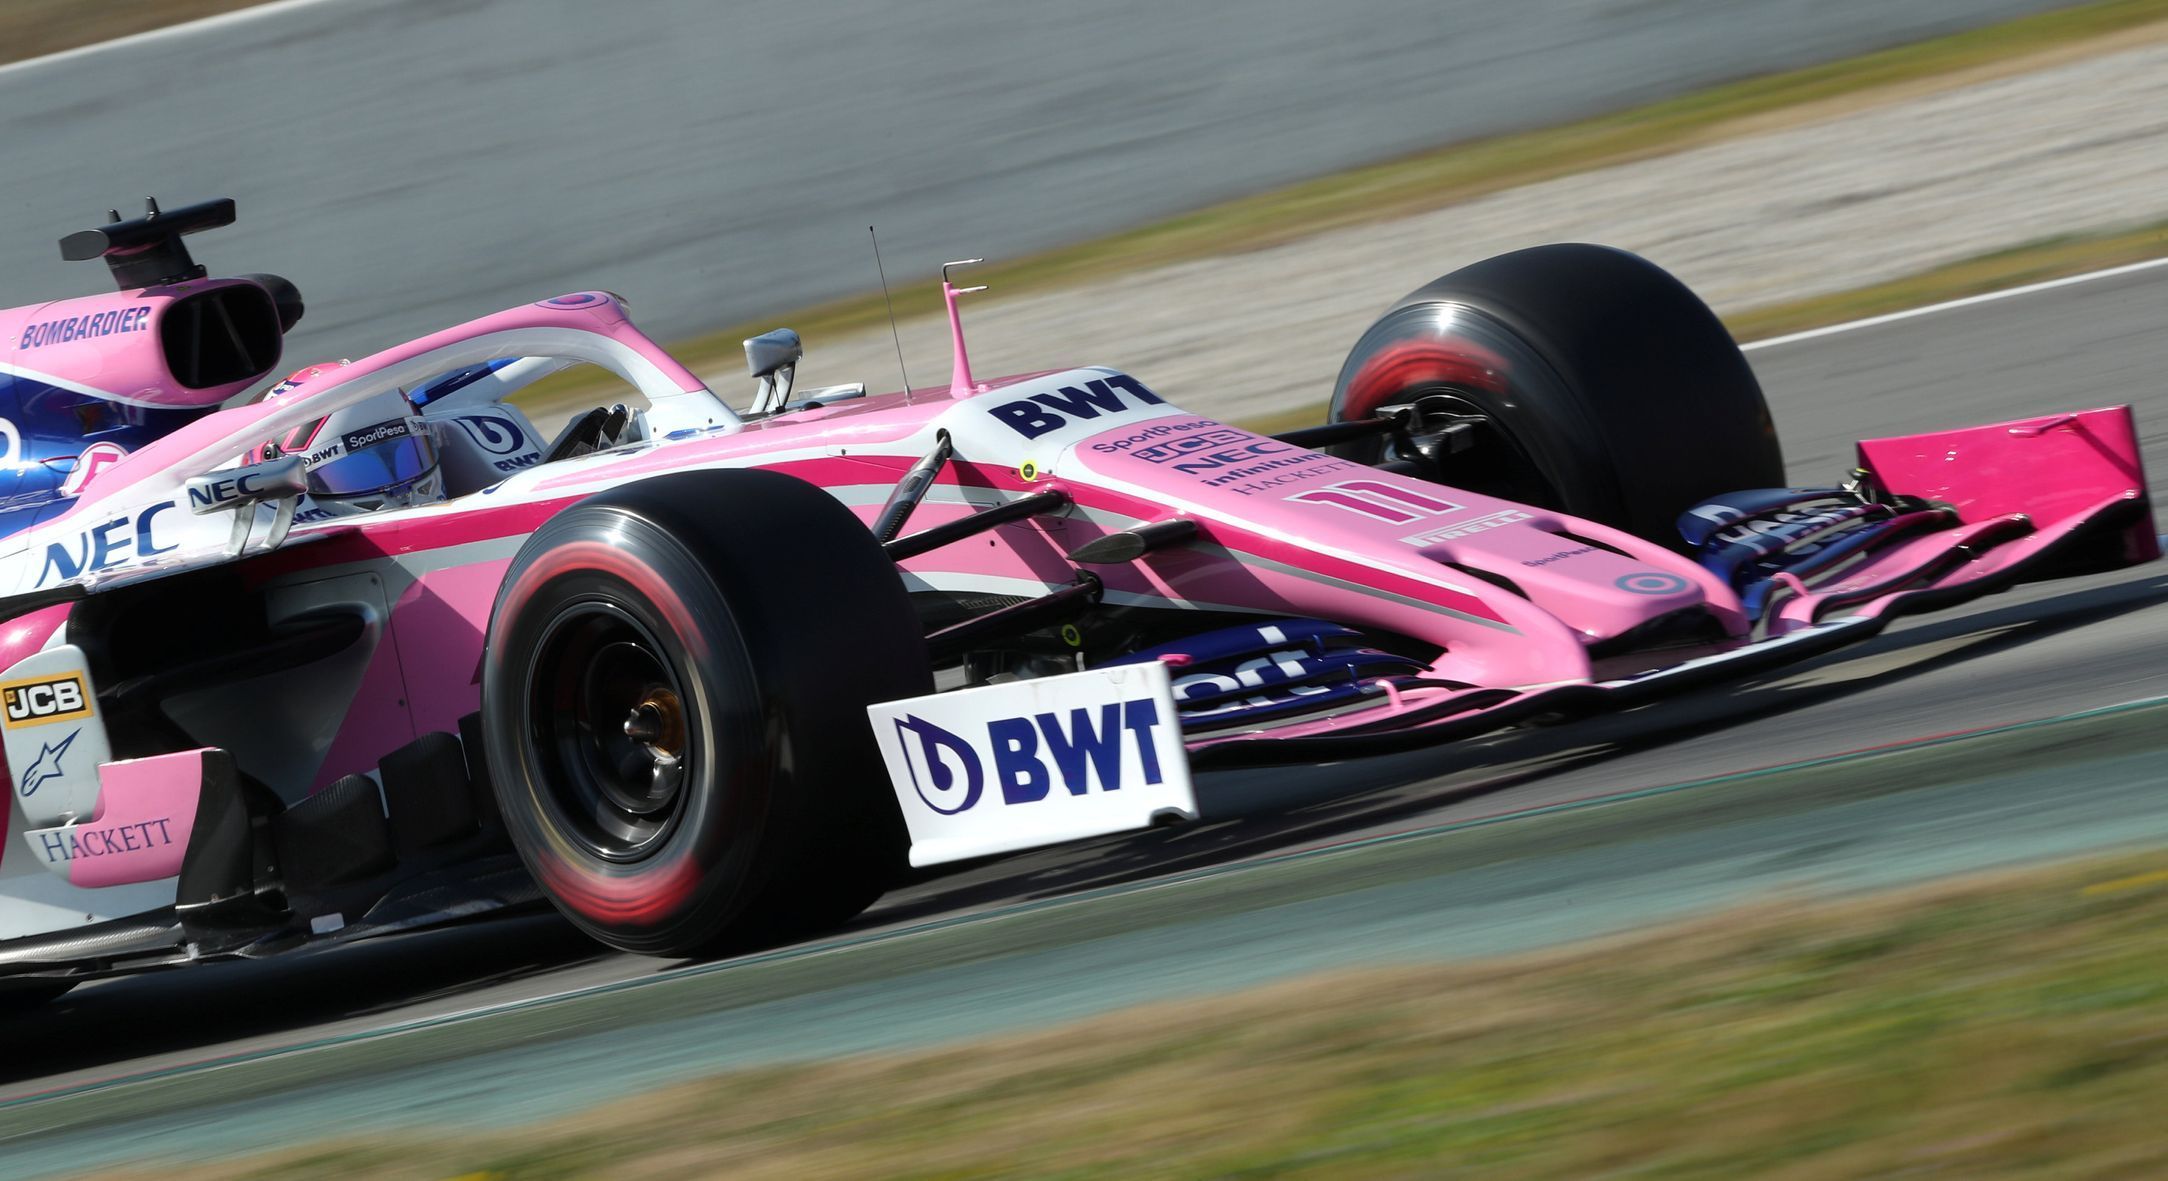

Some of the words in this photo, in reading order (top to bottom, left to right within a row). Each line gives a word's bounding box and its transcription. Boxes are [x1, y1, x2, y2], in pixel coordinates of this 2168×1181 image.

[20, 306, 151, 350] BOMBARDIER
[988, 374, 1167, 440] BWT
[311, 445, 339, 464] BWT
[349, 424, 405, 448] SportPesa
[1092, 420, 1220, 453] SportPesa
[493, 451, 541, 472] BWT
[1171, 441, 1292, 475] NEC
[1200, 452, 1330, 487] infinitum
[188, 473, 264, 508] NEC
[1231, 460, 1361, 496] HACKETT
[1282, 480, 1466, 526] 11
[34, 500, 180, 589] NEC
[1397, 508, 1534, 548] PIRELLI
[8, 681, 84, 719] JCB
[988, 698, 1163, 806] BWT
[40, 818, 171, 862] HACKETT
